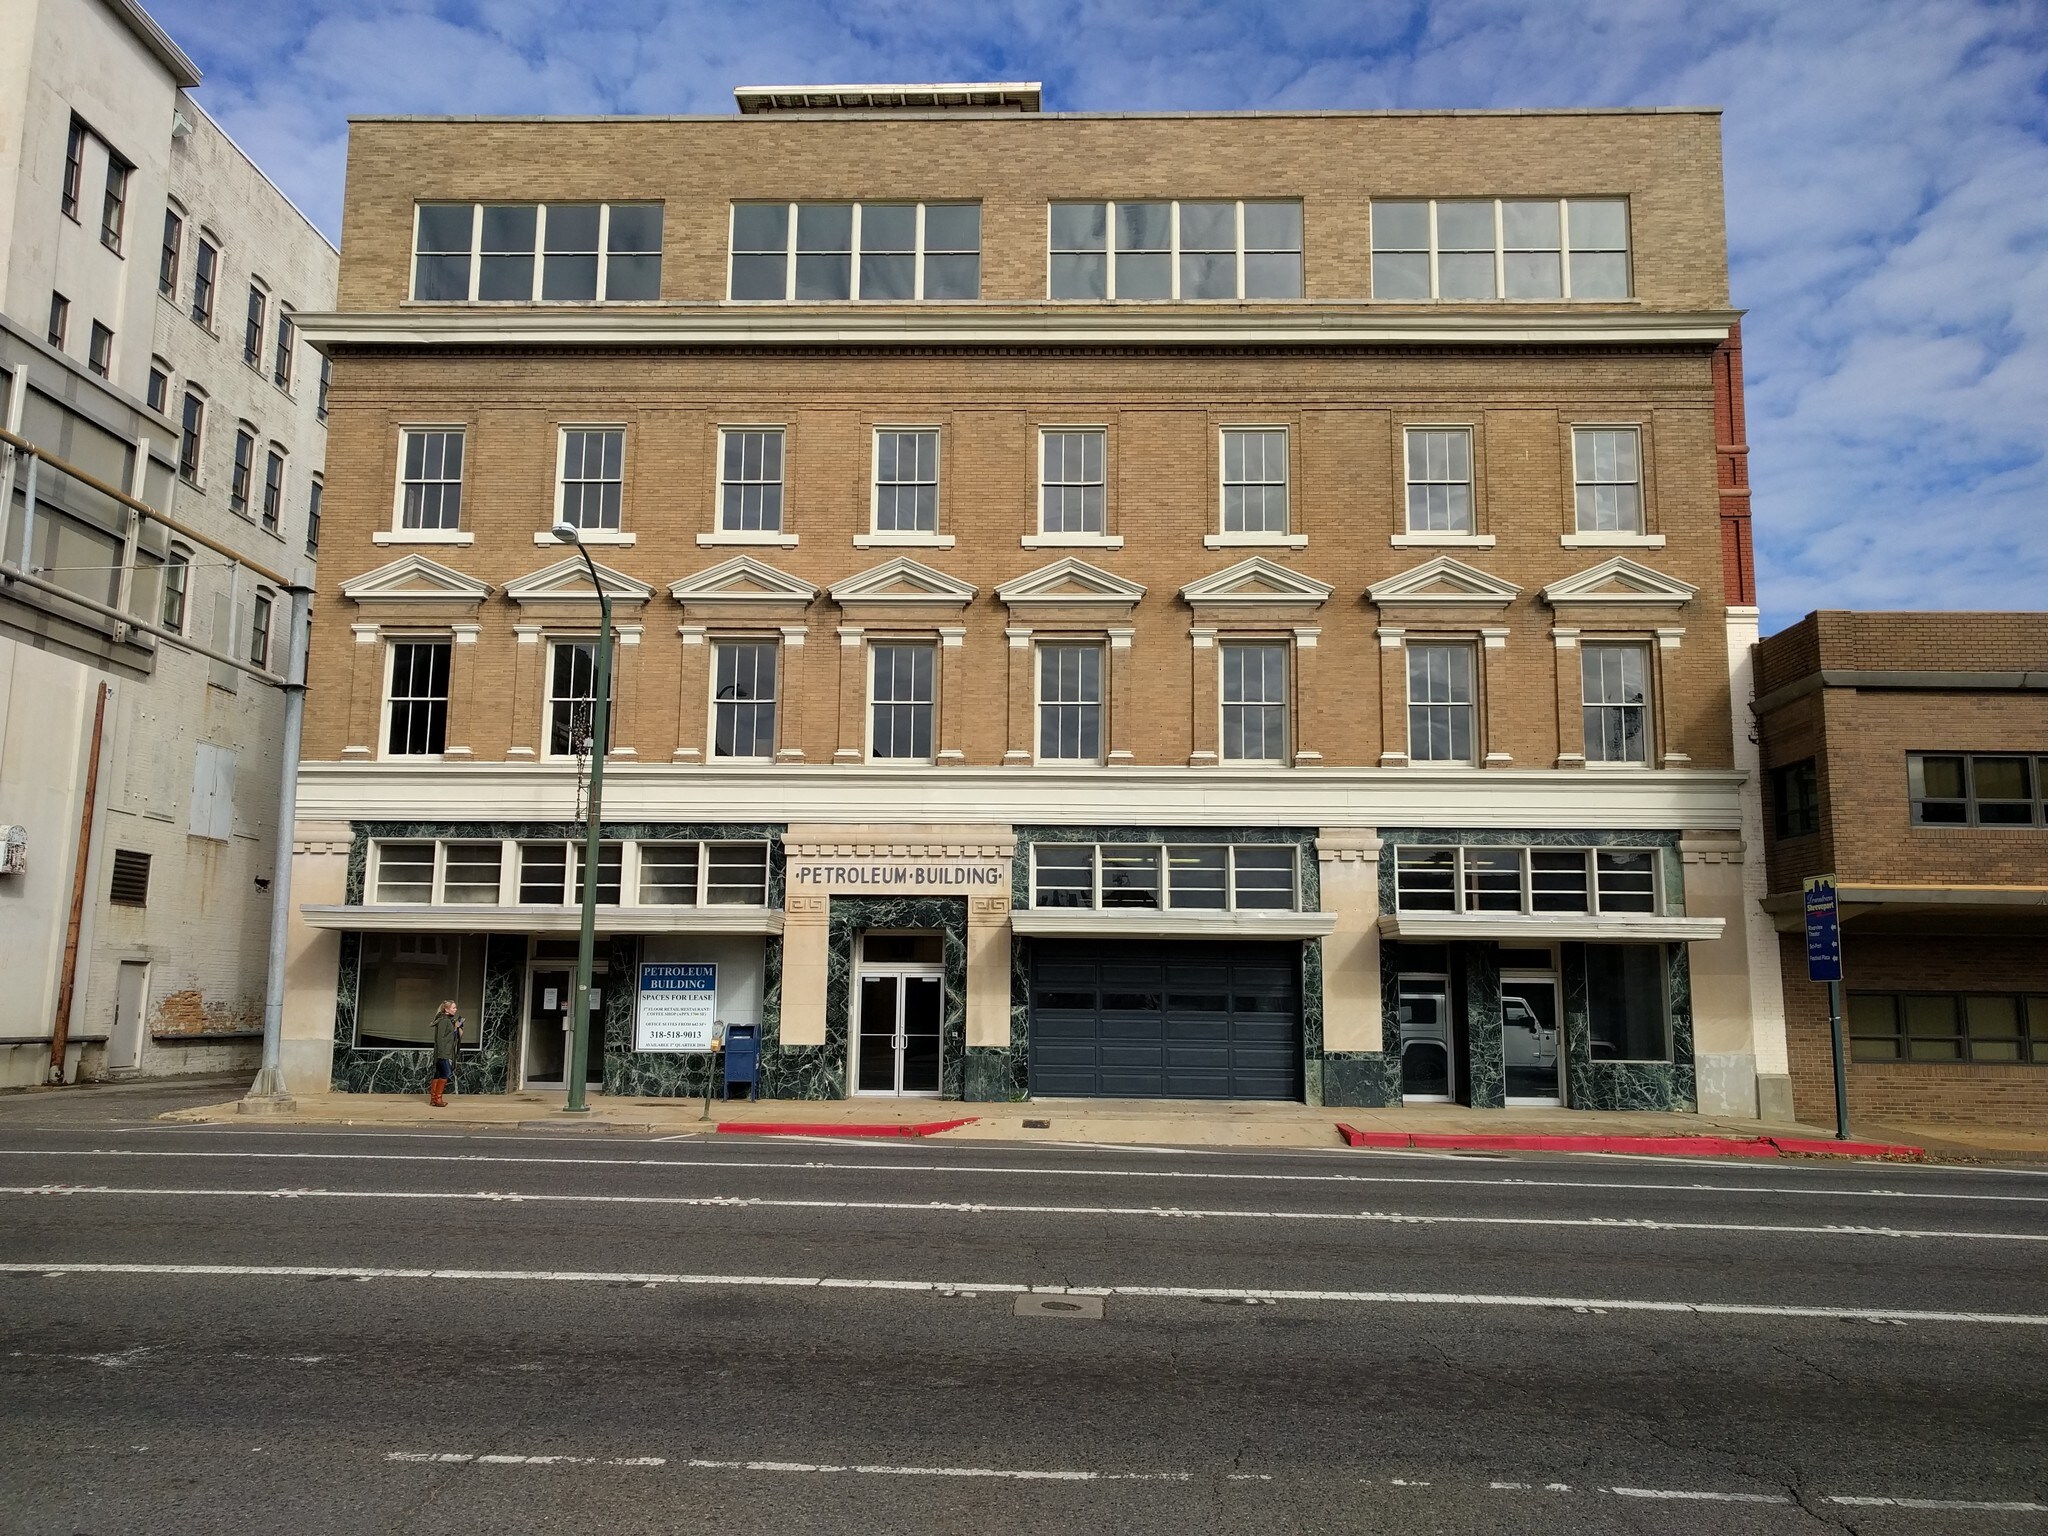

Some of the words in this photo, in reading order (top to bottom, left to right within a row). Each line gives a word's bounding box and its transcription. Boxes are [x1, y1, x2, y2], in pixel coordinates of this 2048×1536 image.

[800, 866, 907, 884] PETROLEUM
[915, 867, 998, 884] BUILDING
[1807, 902, 1834, 911] Shreveport
[644, 967, 713, 976] PETROLEUM
[650, 979, 705, 989] BUILDING
[650, 1031, 702, 1039] 318-518-9013
